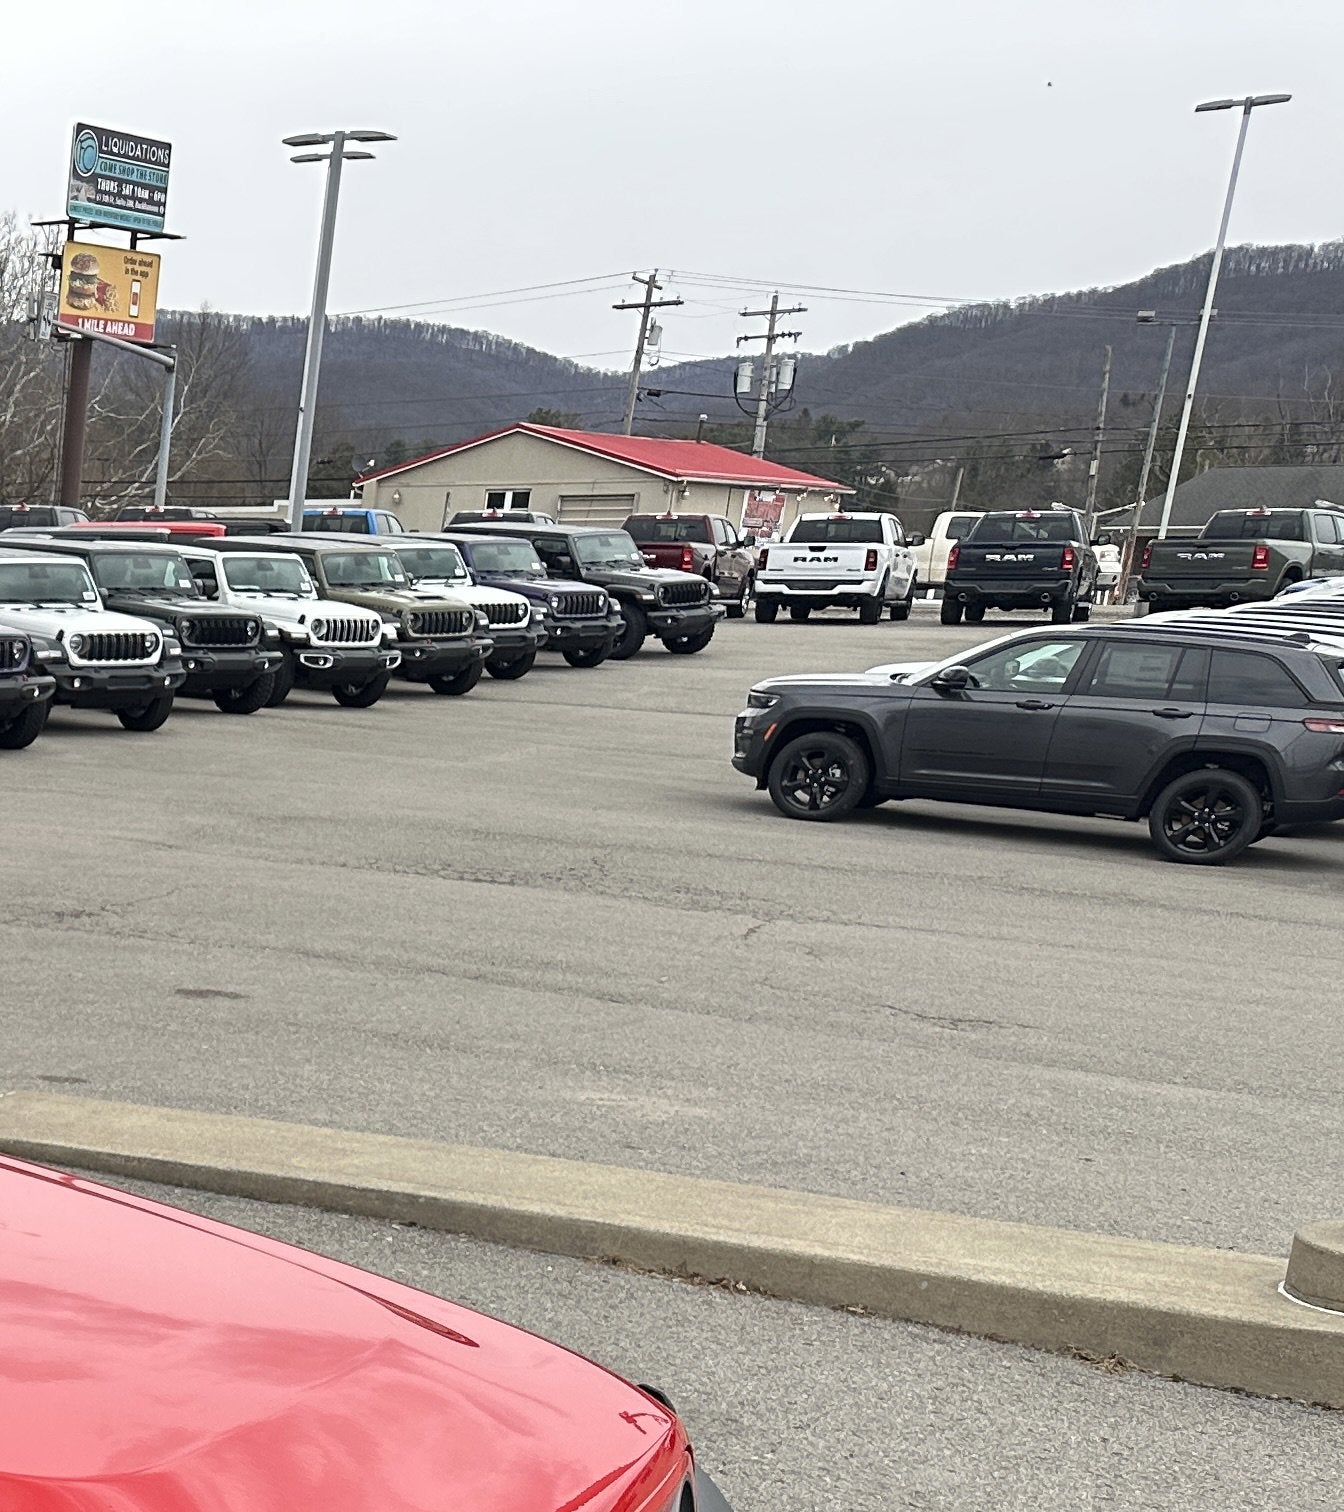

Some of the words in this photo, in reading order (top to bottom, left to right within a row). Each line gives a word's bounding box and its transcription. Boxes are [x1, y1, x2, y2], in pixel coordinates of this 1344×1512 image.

[102, 135, 170, 164] LIQUIDATIONS
[99, 160, 117, 174] COME
[118, 165, 134, 177] SHOP
[136, 169, 148, 181] THE
[148, 172, 168, 184] STORE
[97, 178, 118, 193] THURS
[122, 183, 133, 196] SAT
[131, 268, 139, 276] the
[139, 270, 150, 279] app
[77, 317, 83, 328] 1
[83, 319, 105, 333] MILE
[105, 320, 136, 336] AHEAD
[985, 554, 1035, 562] RAM
[1177, 552, 1226, 561] RAM
